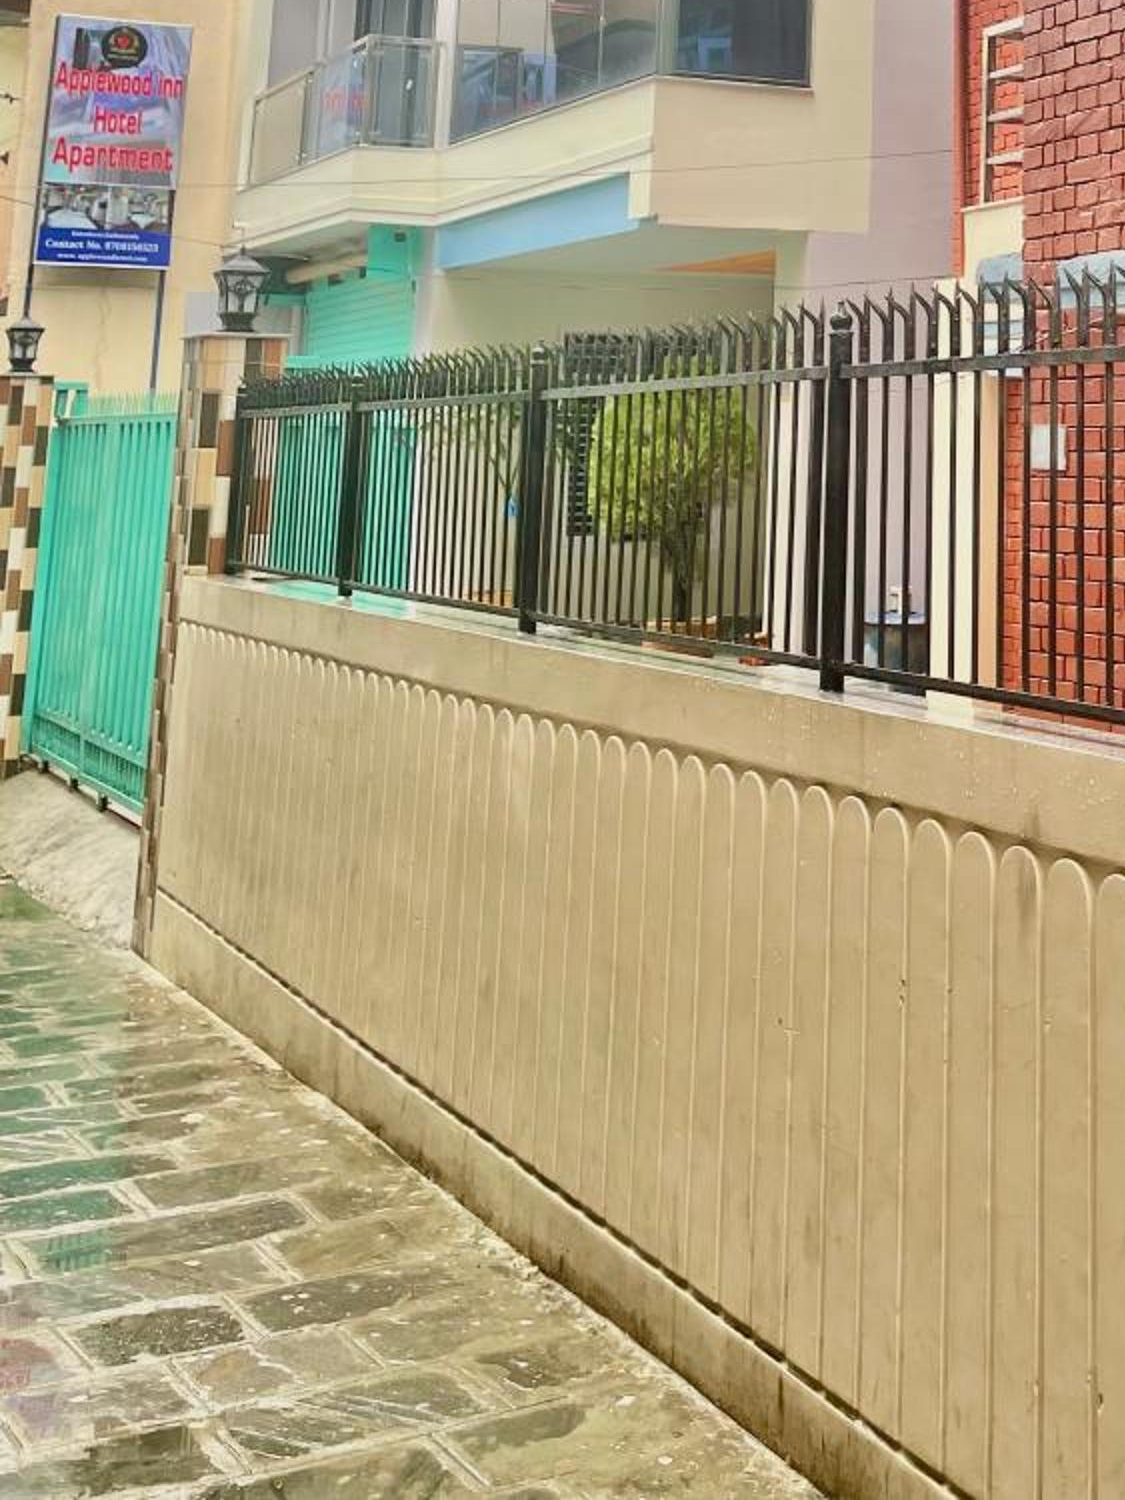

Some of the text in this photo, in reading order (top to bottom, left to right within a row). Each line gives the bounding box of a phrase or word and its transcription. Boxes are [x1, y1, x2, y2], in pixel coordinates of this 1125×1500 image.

[55, 62, 153, 97] Applewood
[94, 106, 142, 134] Hotel
[52, 137, 173, 172] Apartment
[45, 238, 84, 249] Contact
